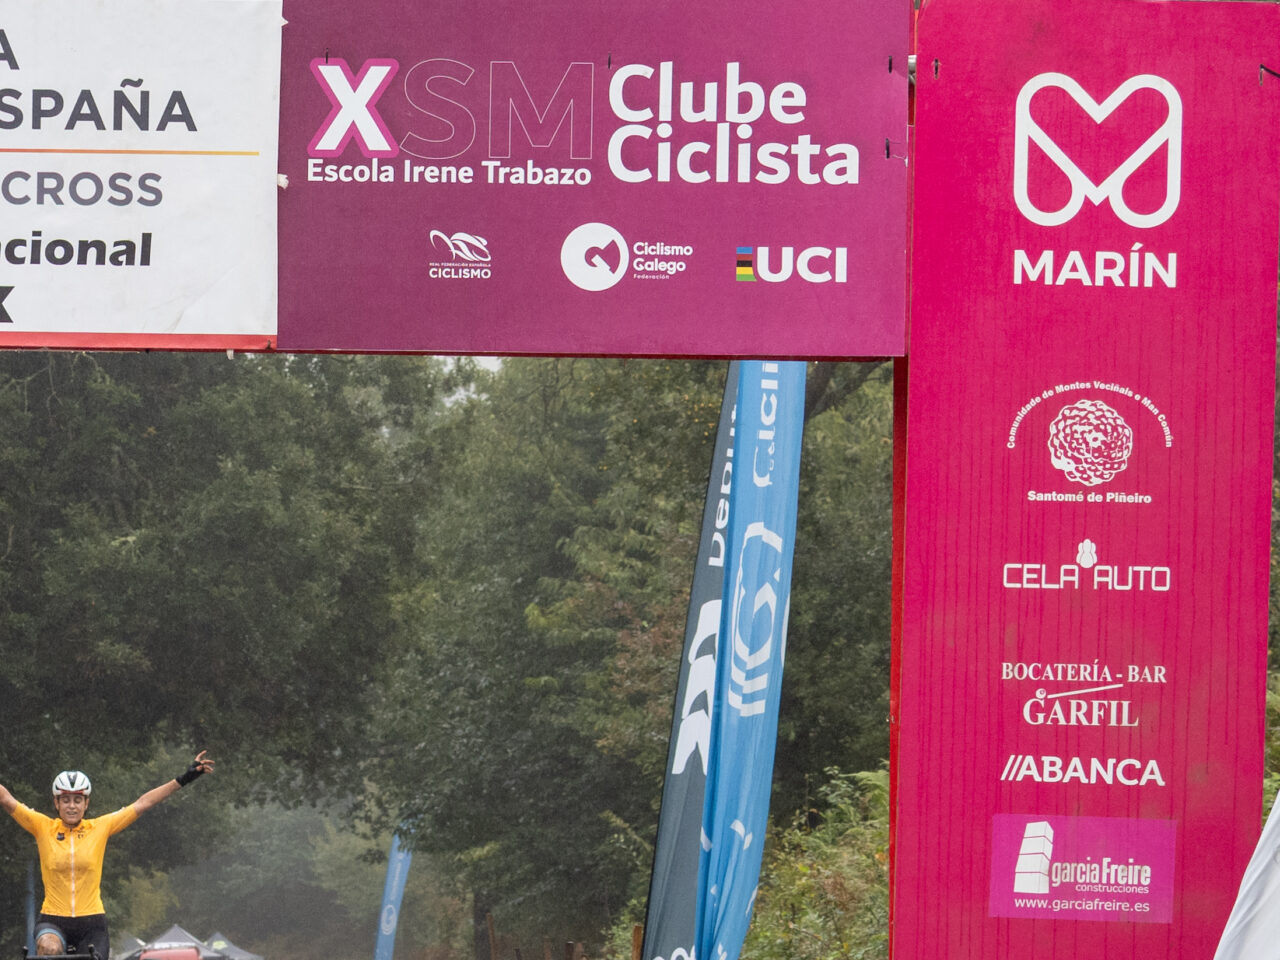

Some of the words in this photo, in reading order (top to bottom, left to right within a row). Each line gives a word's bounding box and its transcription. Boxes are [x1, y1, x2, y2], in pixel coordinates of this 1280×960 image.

[608, 61, 807, 125] Clube
[308, 58, 595, 160] XSM
[607, 121, 860, 185] Ciclista
[307, 159, 395, 183] Escola
[404, 160, 474, 184] Irene
[481, 161, 592, 185] Trabazo
[632, 241, 694, 256] Ciclismo
[429, 268, 492, 279] CICLISMO
[632, 257, 687, 275] Galego
[755, 246, 848, 284] UCI
[1013, 242, 1178, 288] MARÍN
[1054, 380, 1092, 395] Montes
[1093, 380, 1134, 398] Veciñais
[1140, 396, 1160, 416] Man
[1157, 414, 1174, 448] Común
[1027, 490, 1084, 502] Santomé
[1086, 493, 1104, 502] de
[1106, 493, 1152, 504] Piñeiro
[1003, 563, 1079, 589] CELA
[1093, 565, 1170, 591] AUTO
[1001, 659, 1112, 682] BOCATERÍA
[1127, 665, 1167, 683] BAR
[1023, 699, 1139, 727] GARFIL
[1075, 883, 1149, 893] construcciones
[1014, 898, 1150, 912] www.garciafreire.es
